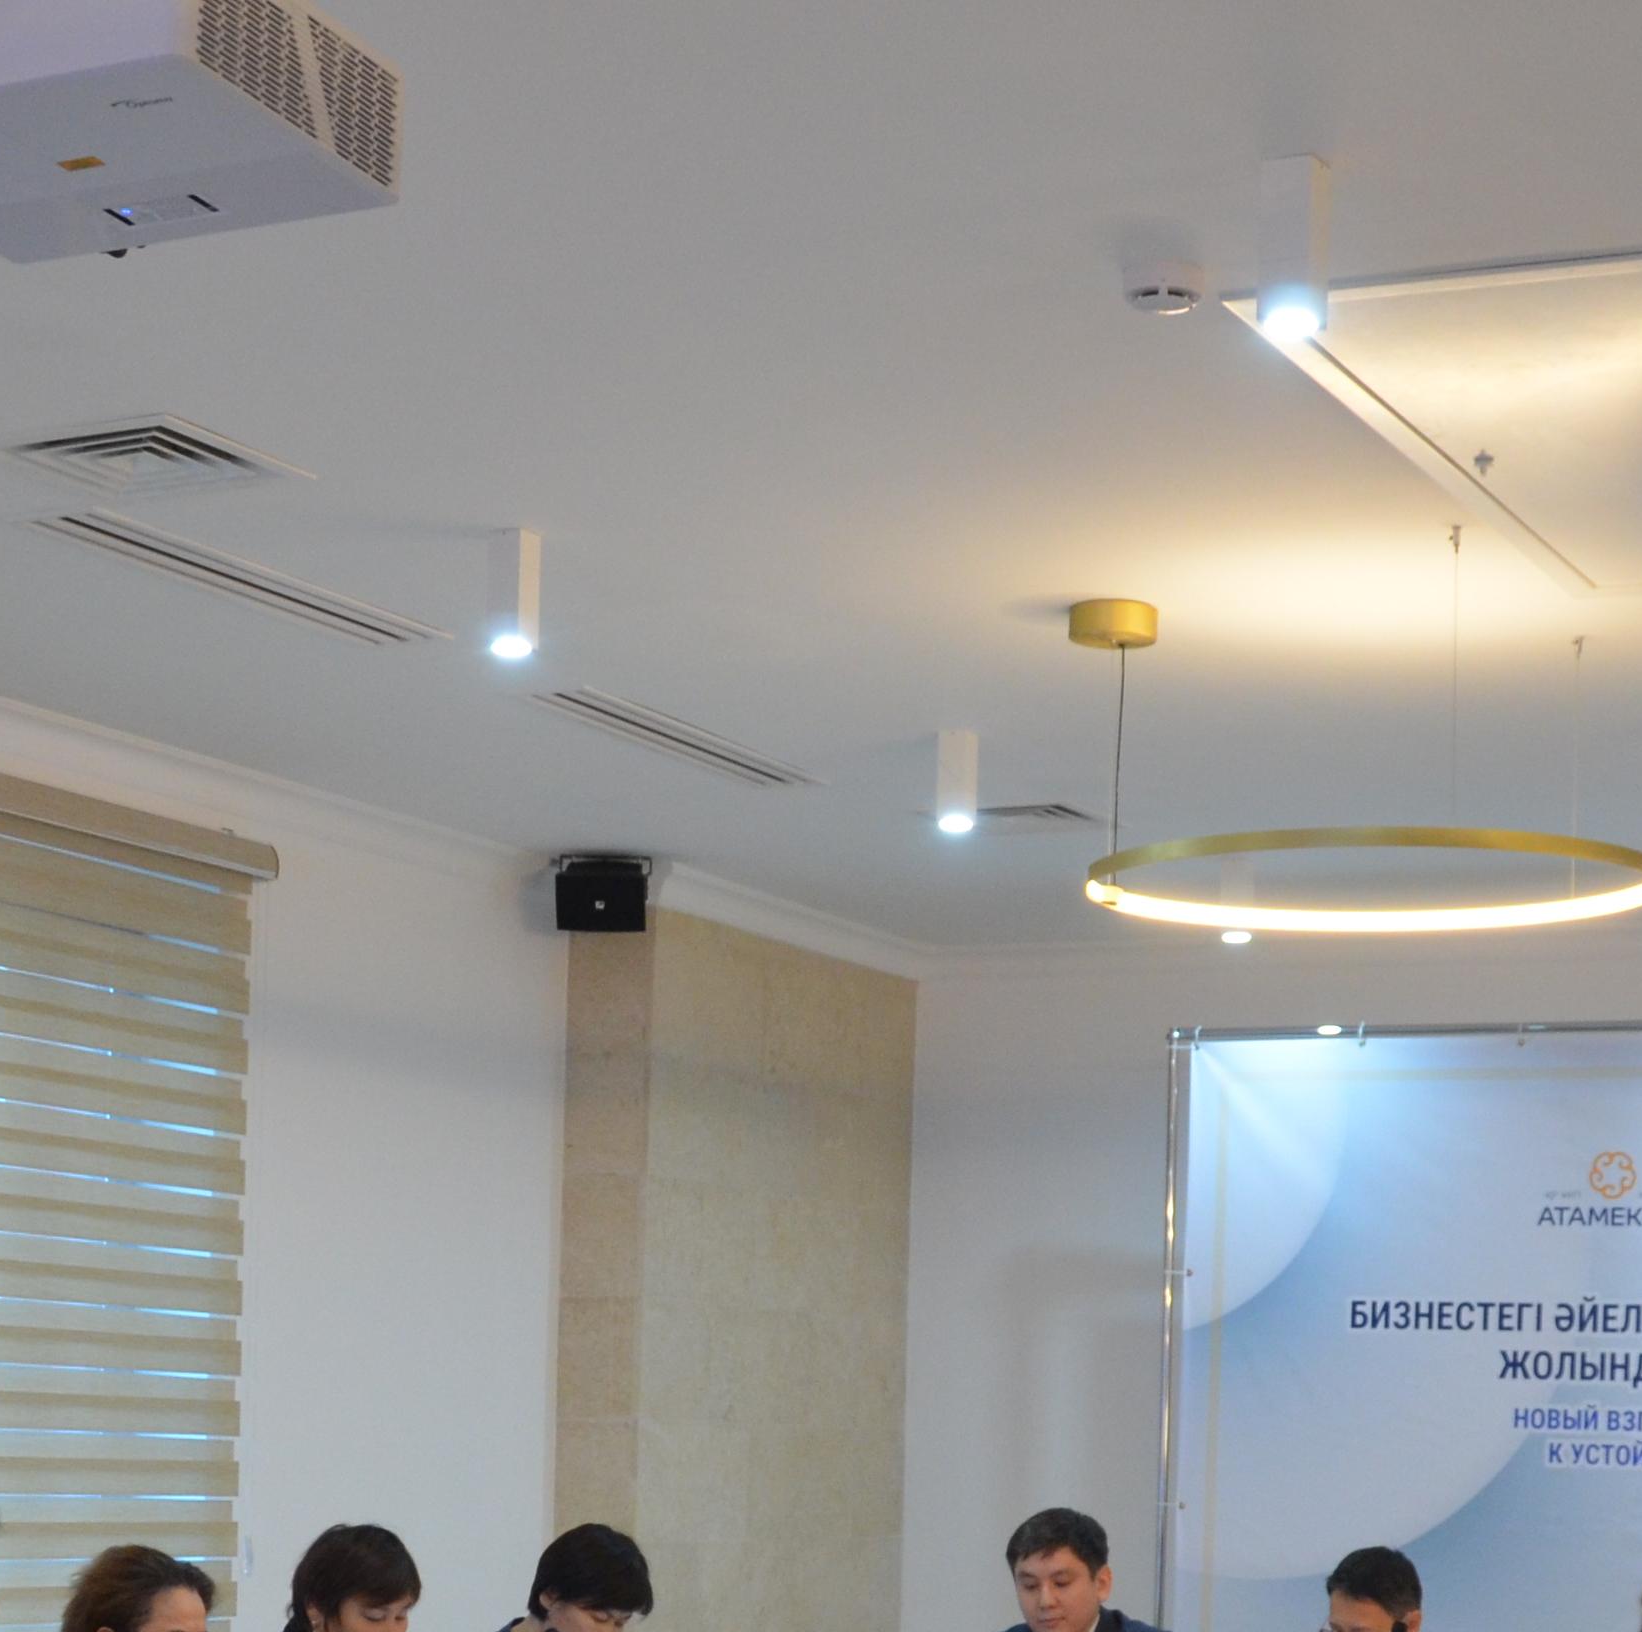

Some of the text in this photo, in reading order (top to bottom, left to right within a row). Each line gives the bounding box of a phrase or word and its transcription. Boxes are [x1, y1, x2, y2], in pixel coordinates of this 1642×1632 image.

[1350, 1300, 1543, 1331] БИЗНЕСТЕГІ
[1513, 1404, 1599, 1430] НОВЫЙ
[1548, 1442, 1563, 1464] К
